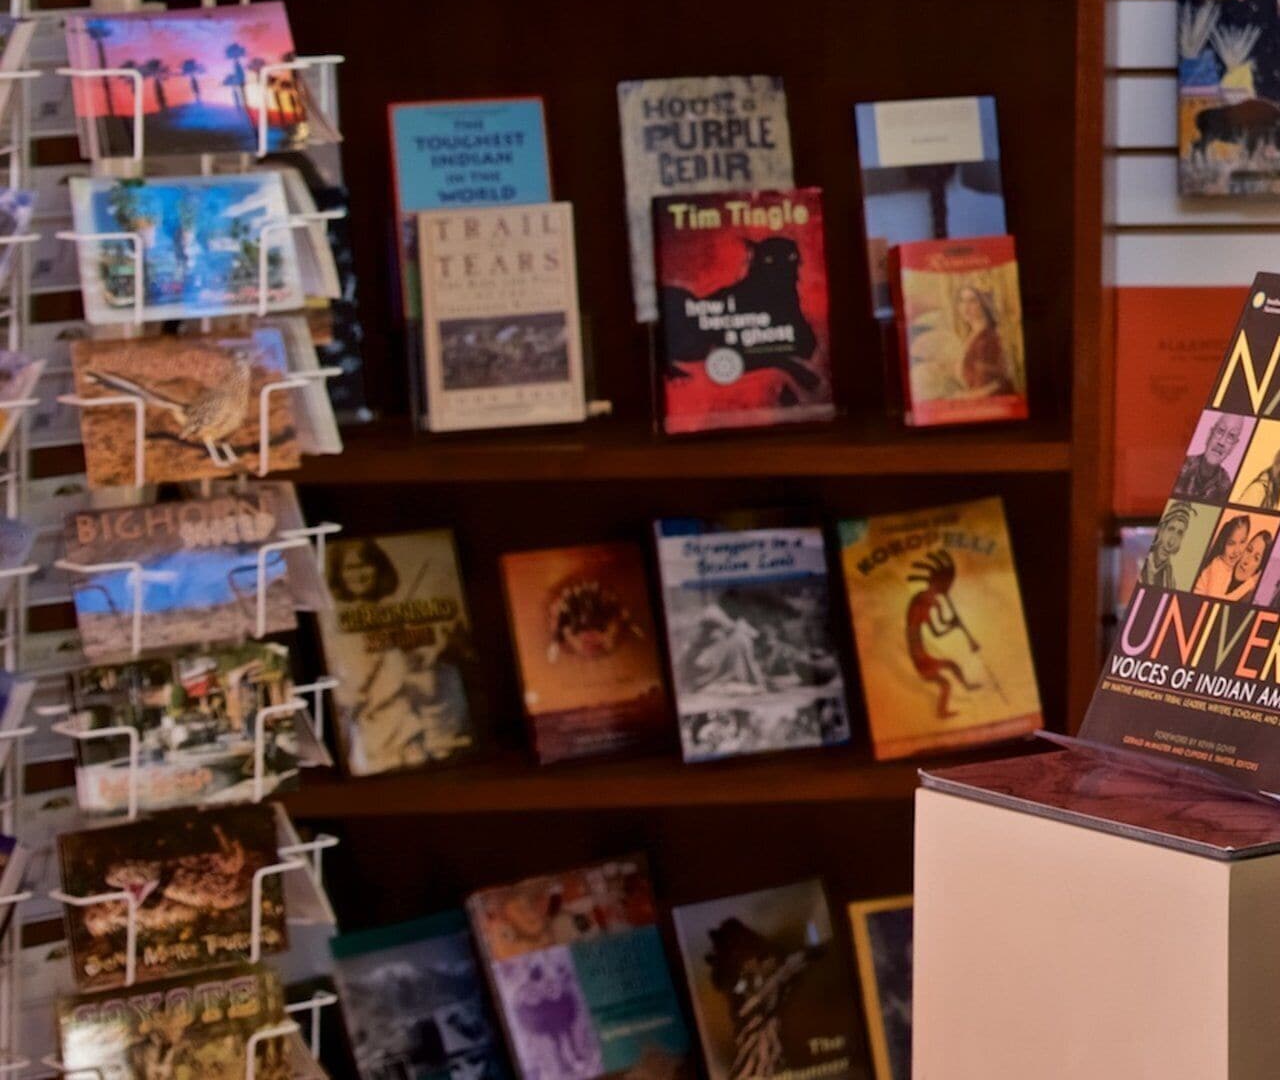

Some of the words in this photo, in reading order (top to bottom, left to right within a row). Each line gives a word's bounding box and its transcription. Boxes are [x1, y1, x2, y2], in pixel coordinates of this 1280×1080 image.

[641, 91, 735, 119] HOUSE
[454, 118, 484, 131] THE
[642, 117, 776, 150] PURPLE
[413, 133, 525, 151] TOUGHEST
[429, 150, 512, 168] INDIAN
[470, 170, 500, 184] THE
[437, 184, 517, 204] WORLD
[668, 203, 722, 231] Tim
[726, 201, 809, 231] Tingle
[434, 214, 561, 242] TRAIL
[434, 251, 560, 279] TEARS
[684, 299, 724, 316] how
[698, 312, 771, 330] became
[726, 331, 738, 346] a
[741, 326, 795, 348] ghost
[74, 496, 272, 545] BIGHORN
[857, 529, 999, 576] KOKOPELLI
[1110, 655, 1169, 685] VOICES
[1170, 667, 1194, 689] OF
[1195, 674, 1255, 704] INDIAN
[807, 1034, 846, 1054] The
